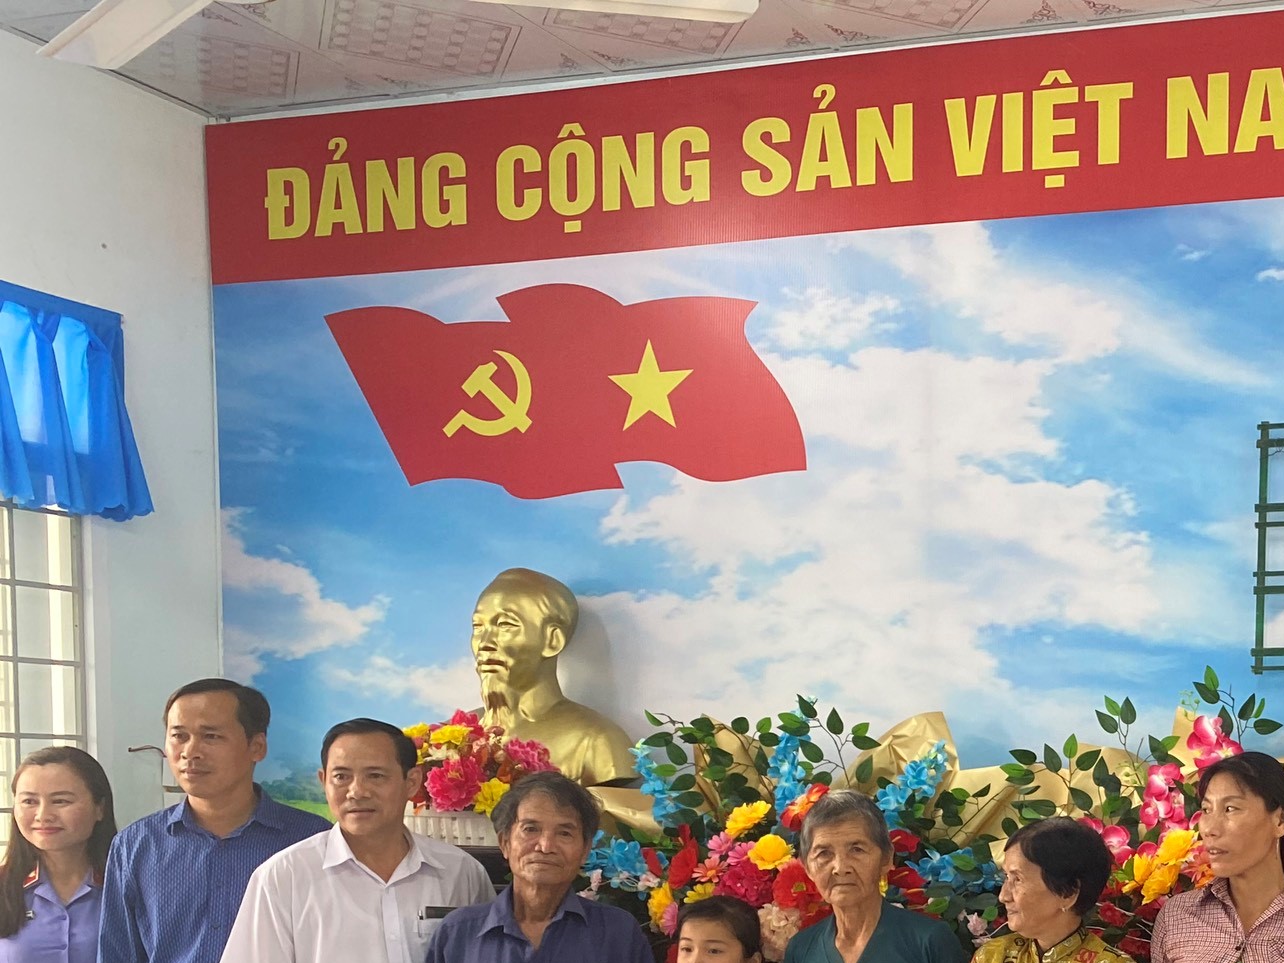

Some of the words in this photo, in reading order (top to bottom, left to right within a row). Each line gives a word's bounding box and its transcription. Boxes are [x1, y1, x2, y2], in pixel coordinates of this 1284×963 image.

[264, 136, 468, 241] ĐẢNG
[495, 122, 711, 233] CỘNG
[741, 84, 914, 197] SẢN
[944, 71, 1134, 189] VIỆT
